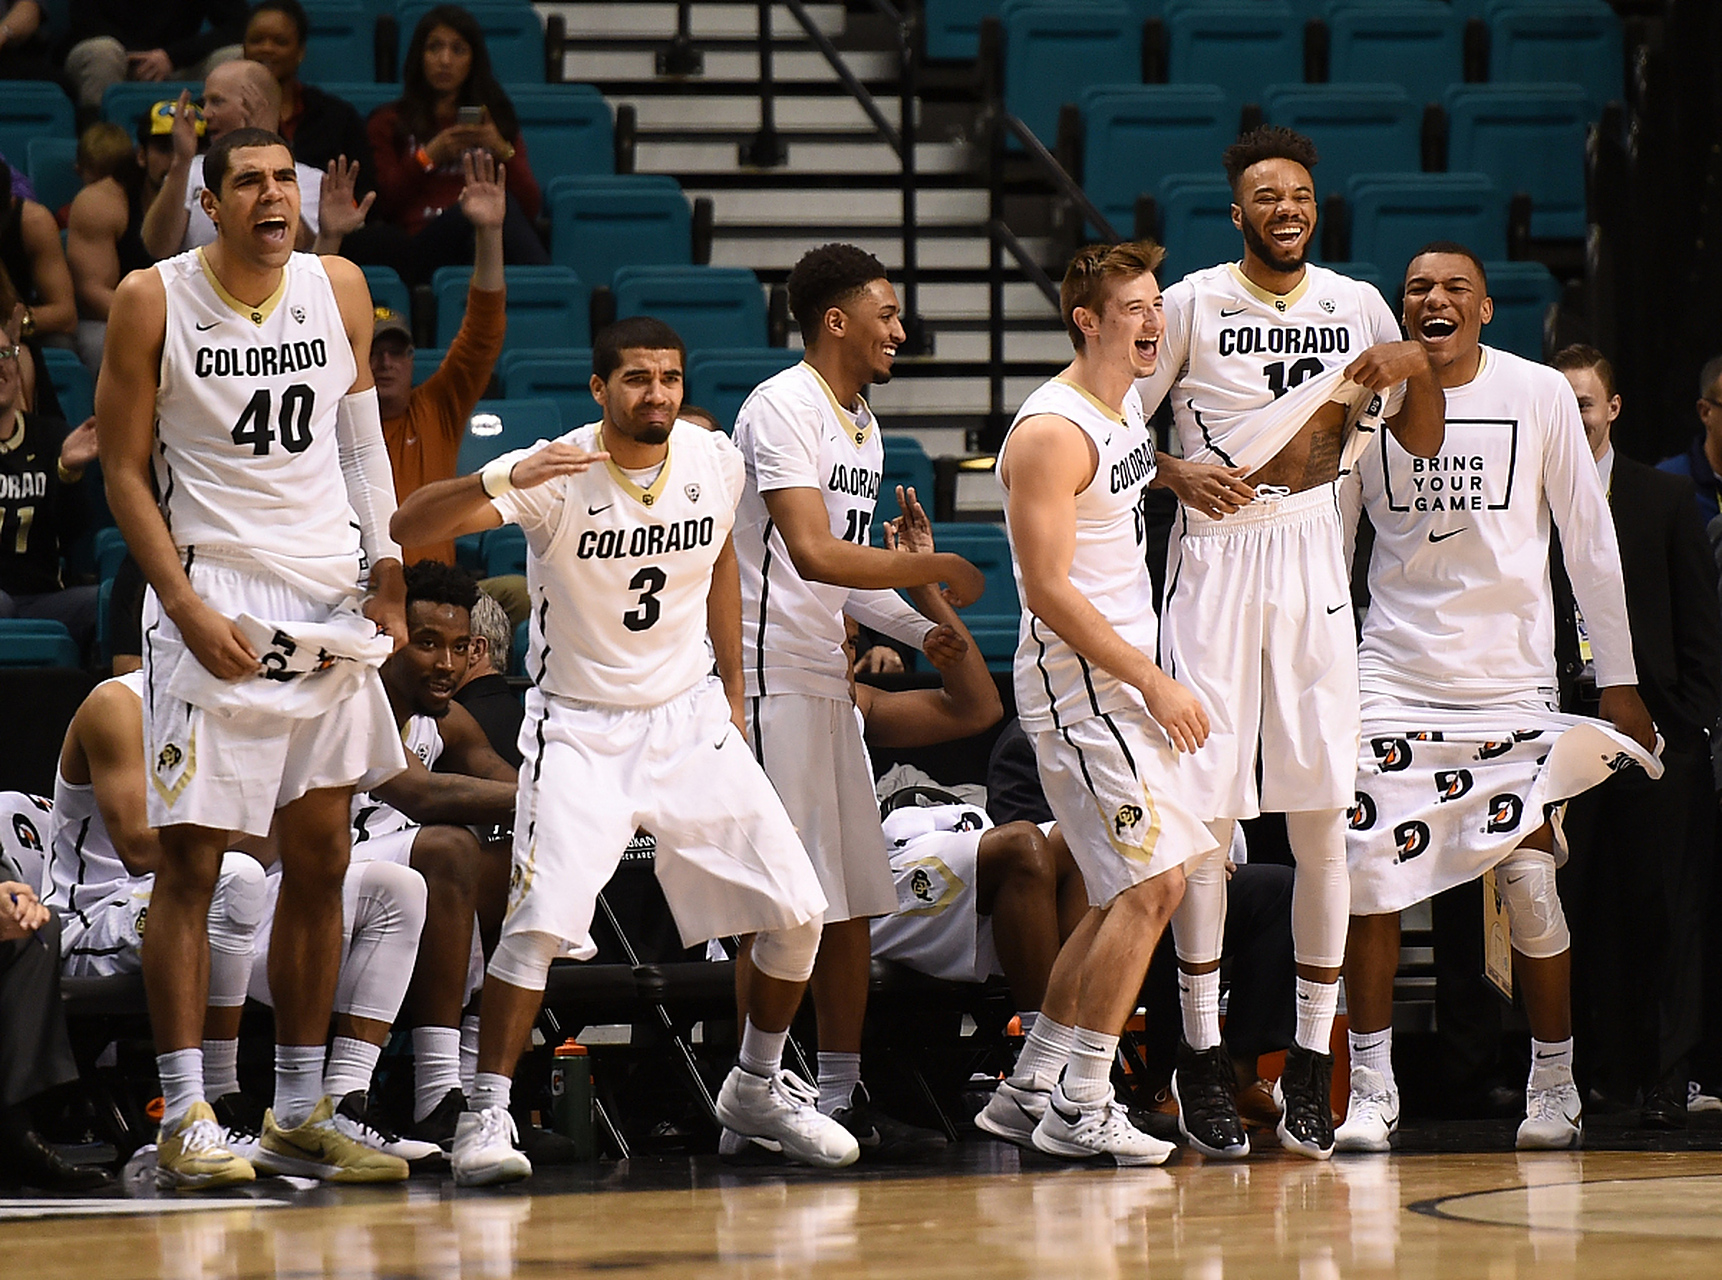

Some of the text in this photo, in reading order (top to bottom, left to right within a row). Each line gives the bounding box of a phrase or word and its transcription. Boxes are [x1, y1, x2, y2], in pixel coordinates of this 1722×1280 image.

[195, 338, 327, 378] COLORADO
[1218, 326, 1350, 357] COLORADO
[231, 383, 316, 456] 40
[1413, 456, 1484, 472] BRING
[1413, 476, 1482, 492] YOUR
[1414, 496, 1482, 512] GAME
[576, 516, 714, 559] COLORADO
[622, 566, 667, 632] 3
